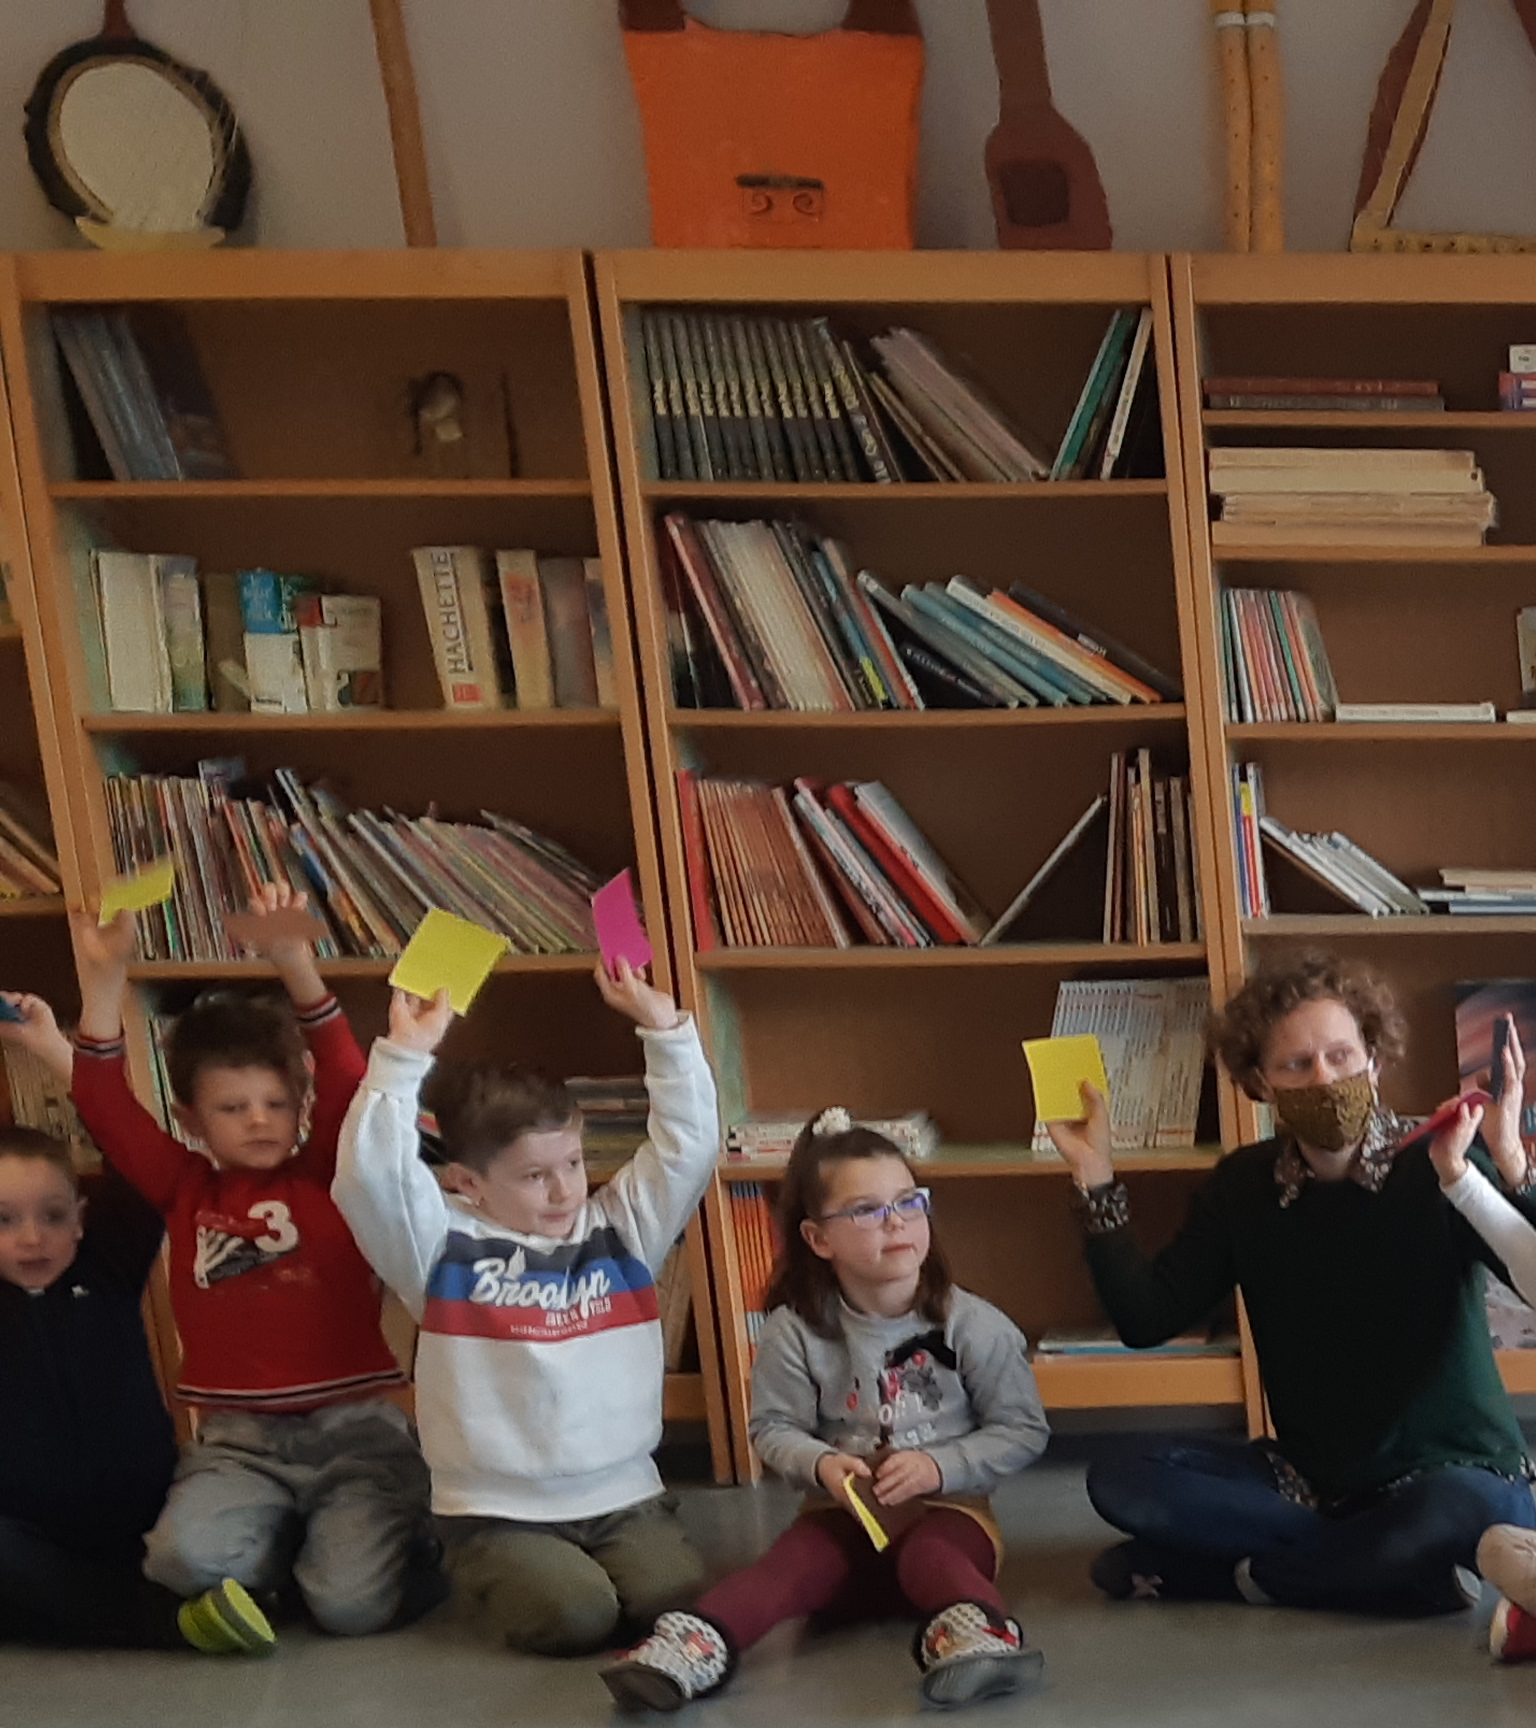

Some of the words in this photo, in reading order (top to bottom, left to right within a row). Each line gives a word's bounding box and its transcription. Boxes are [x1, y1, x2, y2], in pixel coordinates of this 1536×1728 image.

[430, 552, 468, 674] HACHETTE
[248, 1200, 299, 1253] 3
[468, 1257, 611, 1318] Broolyn
